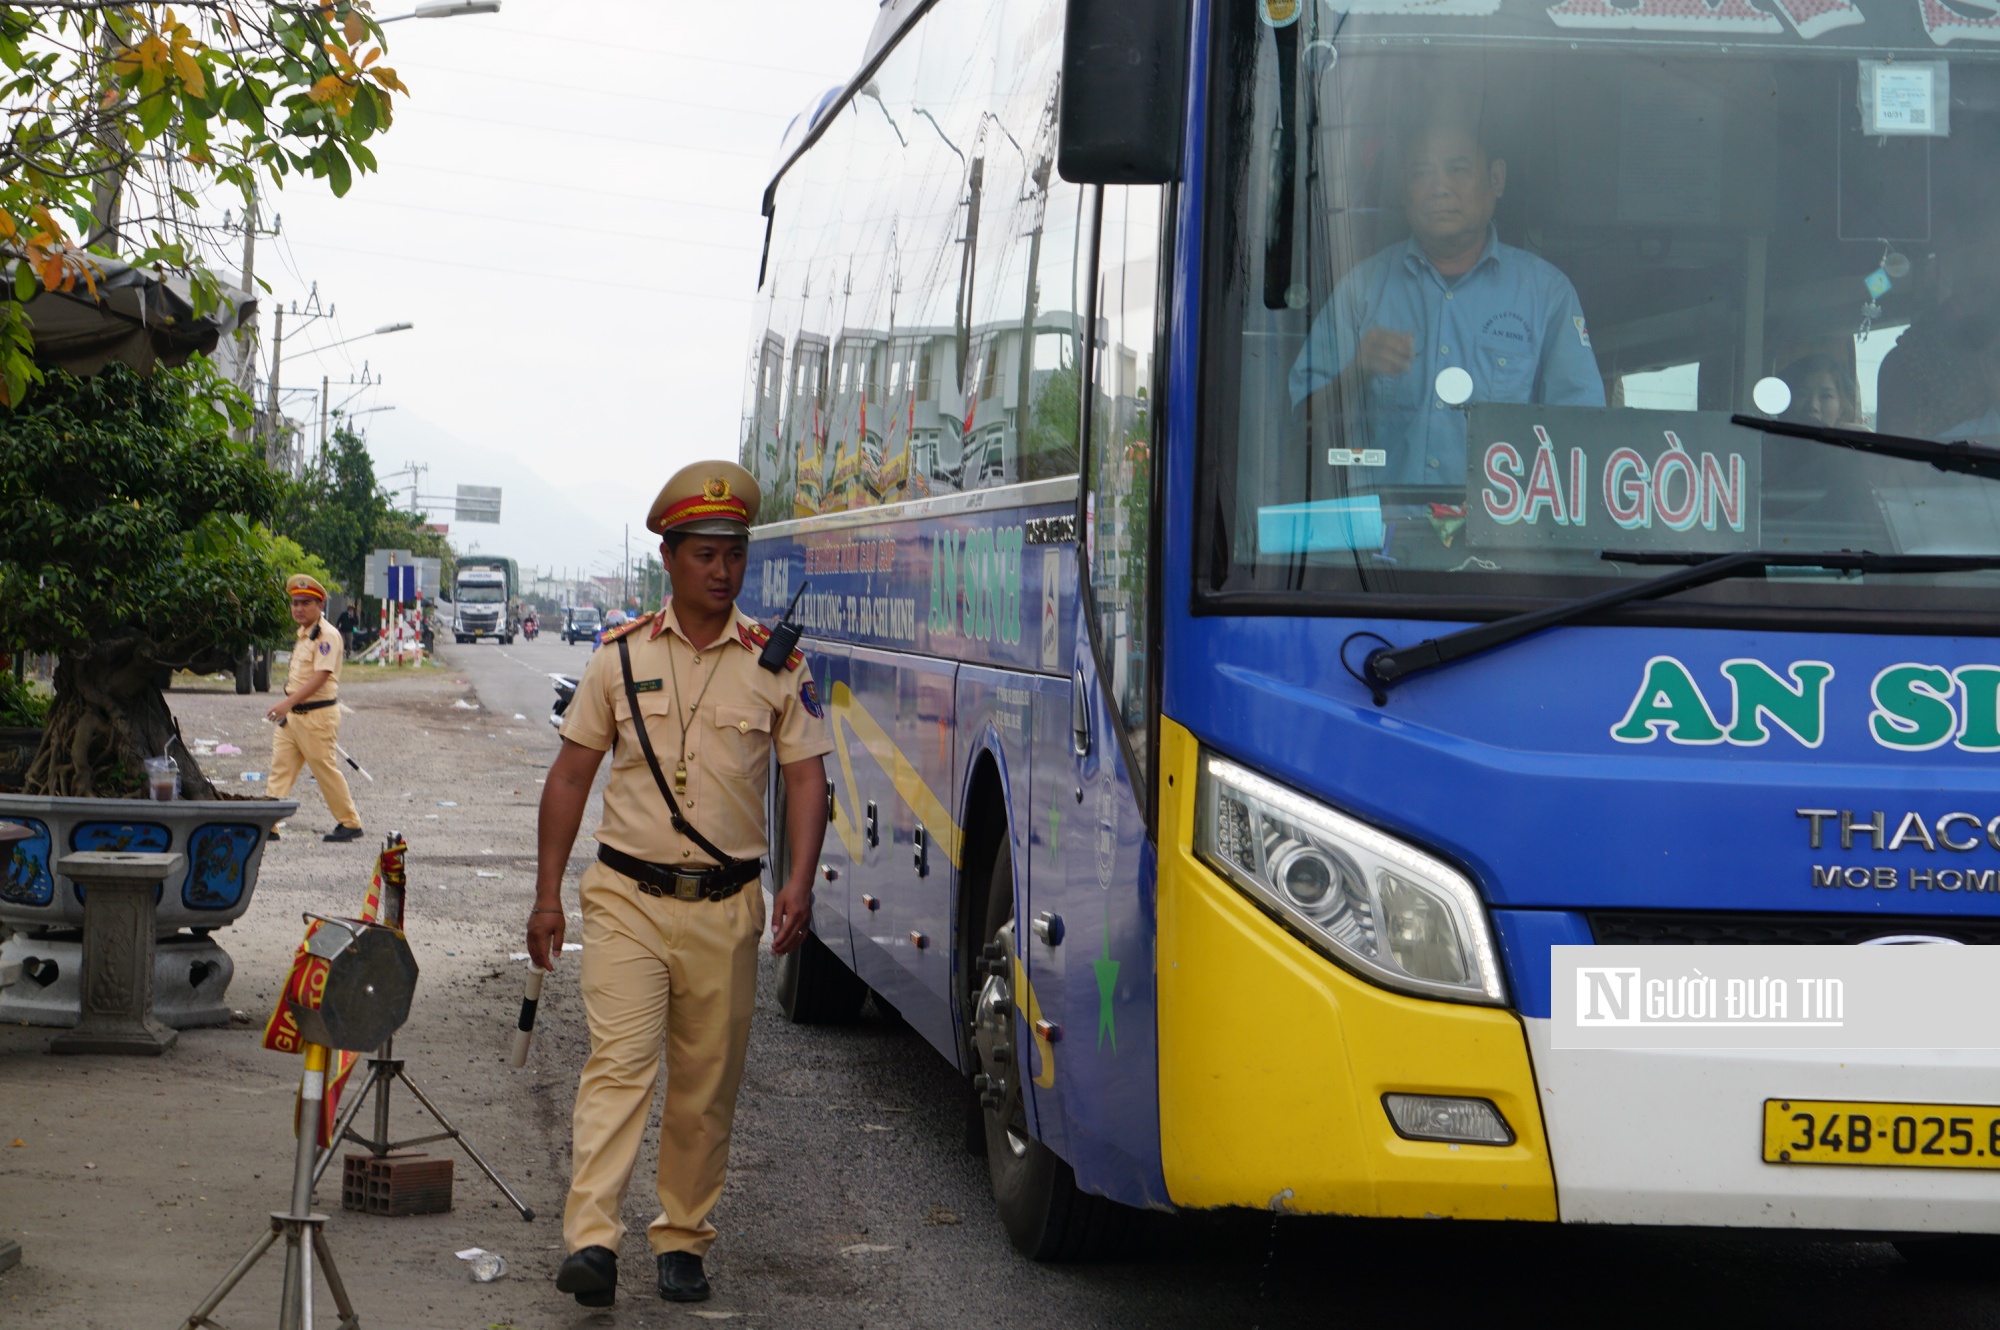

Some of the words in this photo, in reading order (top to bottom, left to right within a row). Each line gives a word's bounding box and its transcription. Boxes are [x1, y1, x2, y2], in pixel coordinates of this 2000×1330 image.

[1482, 425, 1586, 527] SÀI
[1603, 431, 1745, 532] GÒN
[860, 574, 872, 636] HỒ
[873, 582, 889, 639] CHÍ
[890, 597, 915, 642] MINH
[927, 529, 960, 637] AN
[963, 525, 1023, 646] SINH
[1610, 655, 1835, 748] AN
[1869, 662, 2000, 753] SI
[1795, 808, 2000, 852] THAC
[1812, 864, 1898, 890] MOB
[1909, 866, 2000, 893] HOM
